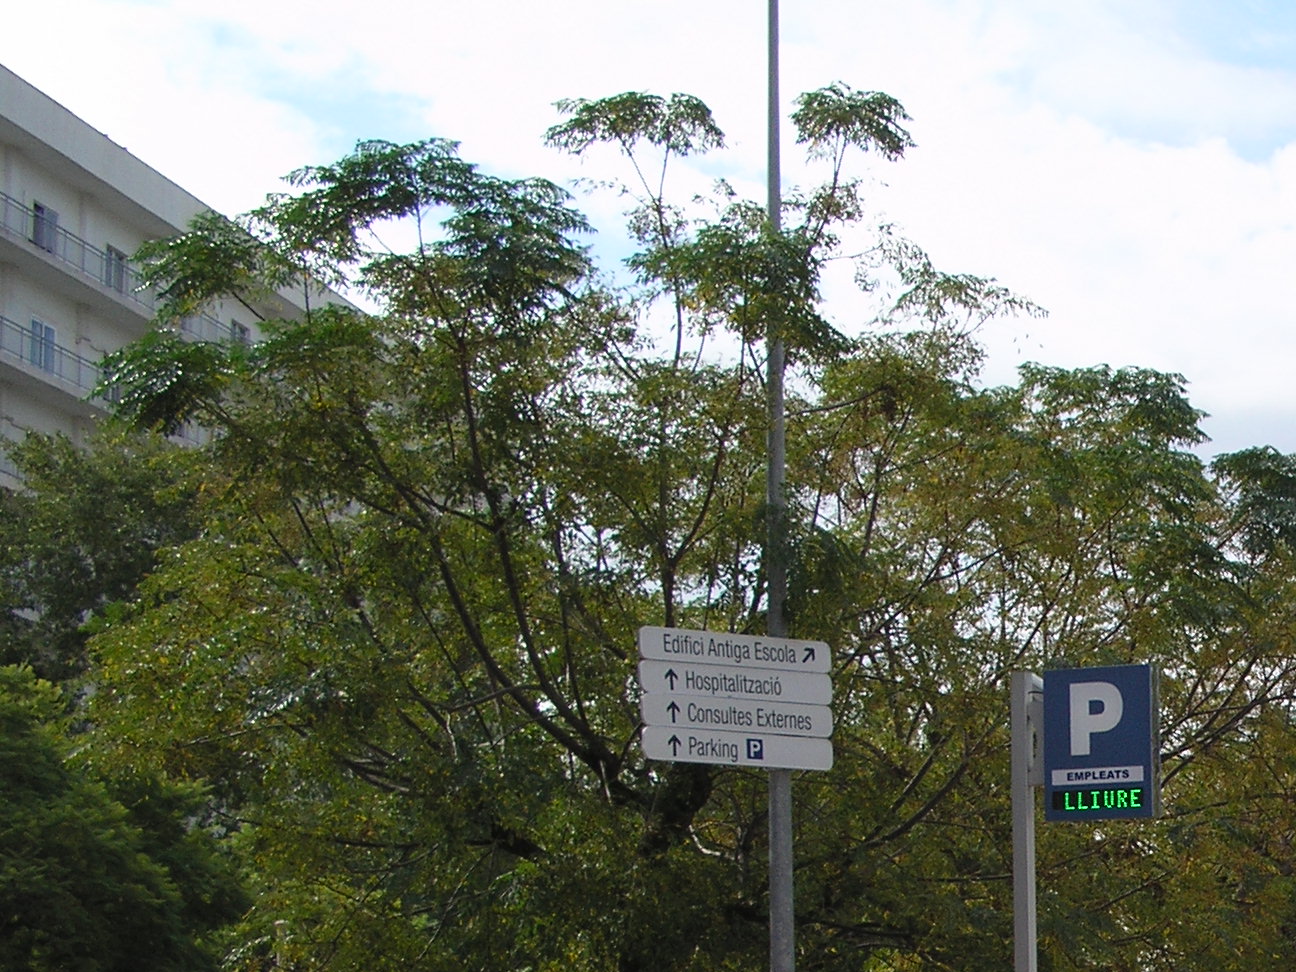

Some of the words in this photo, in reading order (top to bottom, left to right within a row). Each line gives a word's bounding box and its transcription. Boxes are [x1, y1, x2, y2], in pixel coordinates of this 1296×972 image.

[663, 633, 703, 656] Edifici
[708, 638, 750, 663] Antiga
[754, 642, 796, 663] Escola
[685, 671, 782, 696] Hospitalització
[687, 703, 752, 727] Consultes
[757, 708, 812, 731] Externes
[1069, 681, 1124, 756] P
[688, 736, 738, 762] Parking
[1066, 769, 1130, 782] EMPLEATS
[1064, 789, 1141, 811] LLIURE
